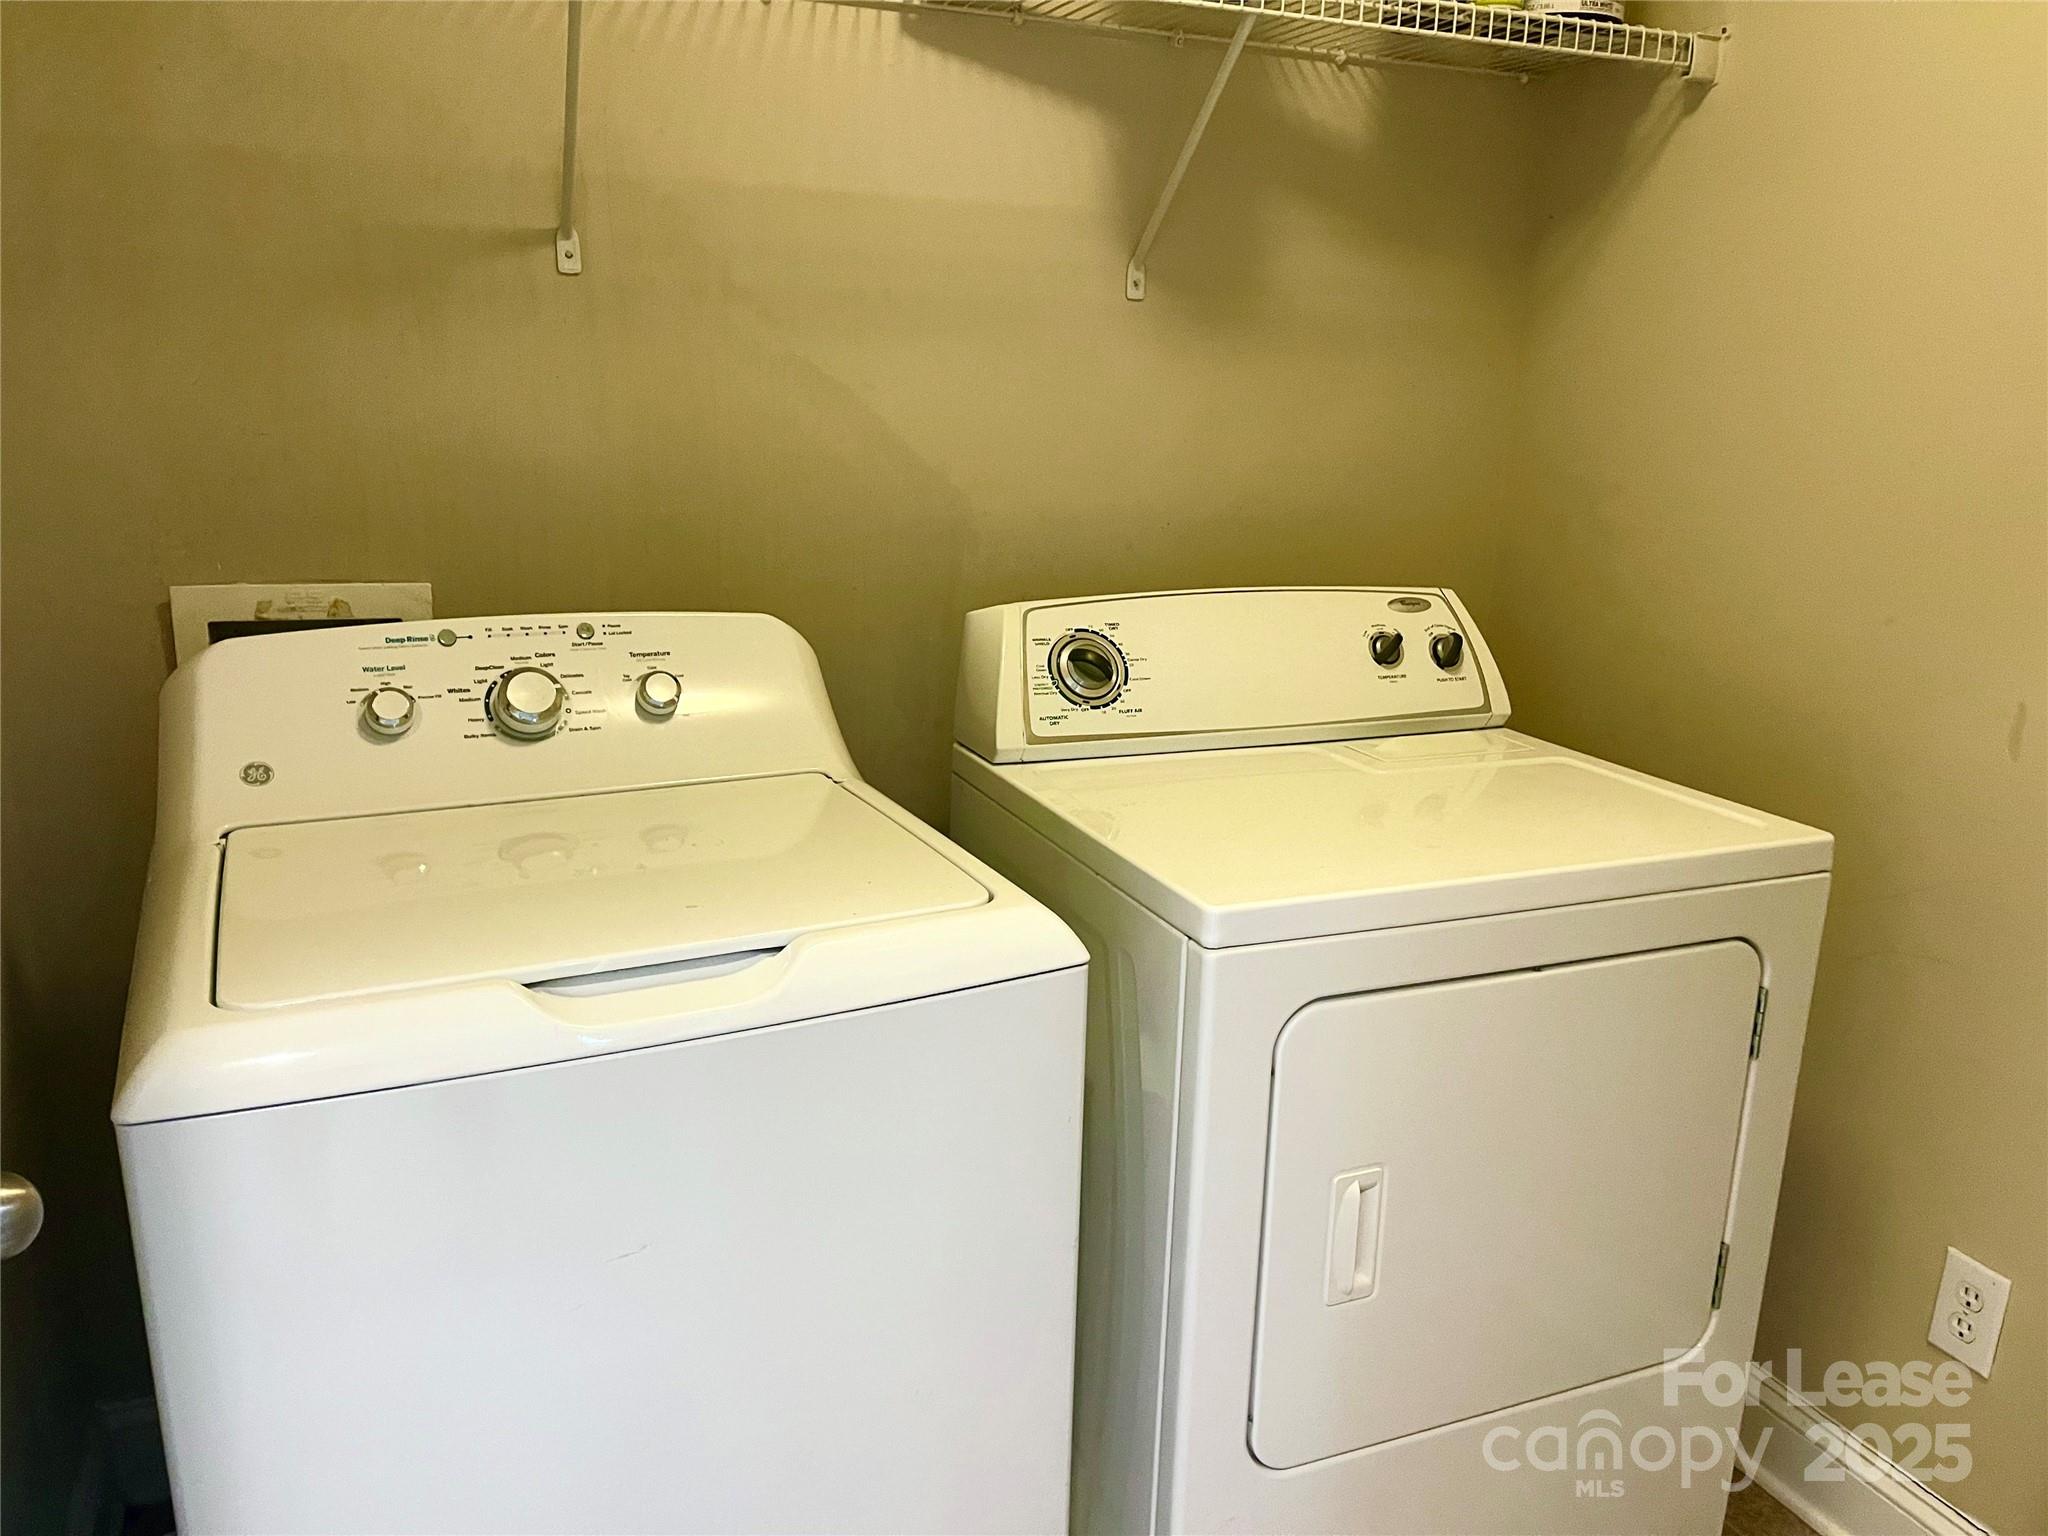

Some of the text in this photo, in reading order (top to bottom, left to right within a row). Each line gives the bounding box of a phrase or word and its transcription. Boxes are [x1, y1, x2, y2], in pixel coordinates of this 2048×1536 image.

[385, 635, 429, 644] Deep Rinse
[628, 650, 671, 658] Temperature
[386, 664, 406, 672] Level
